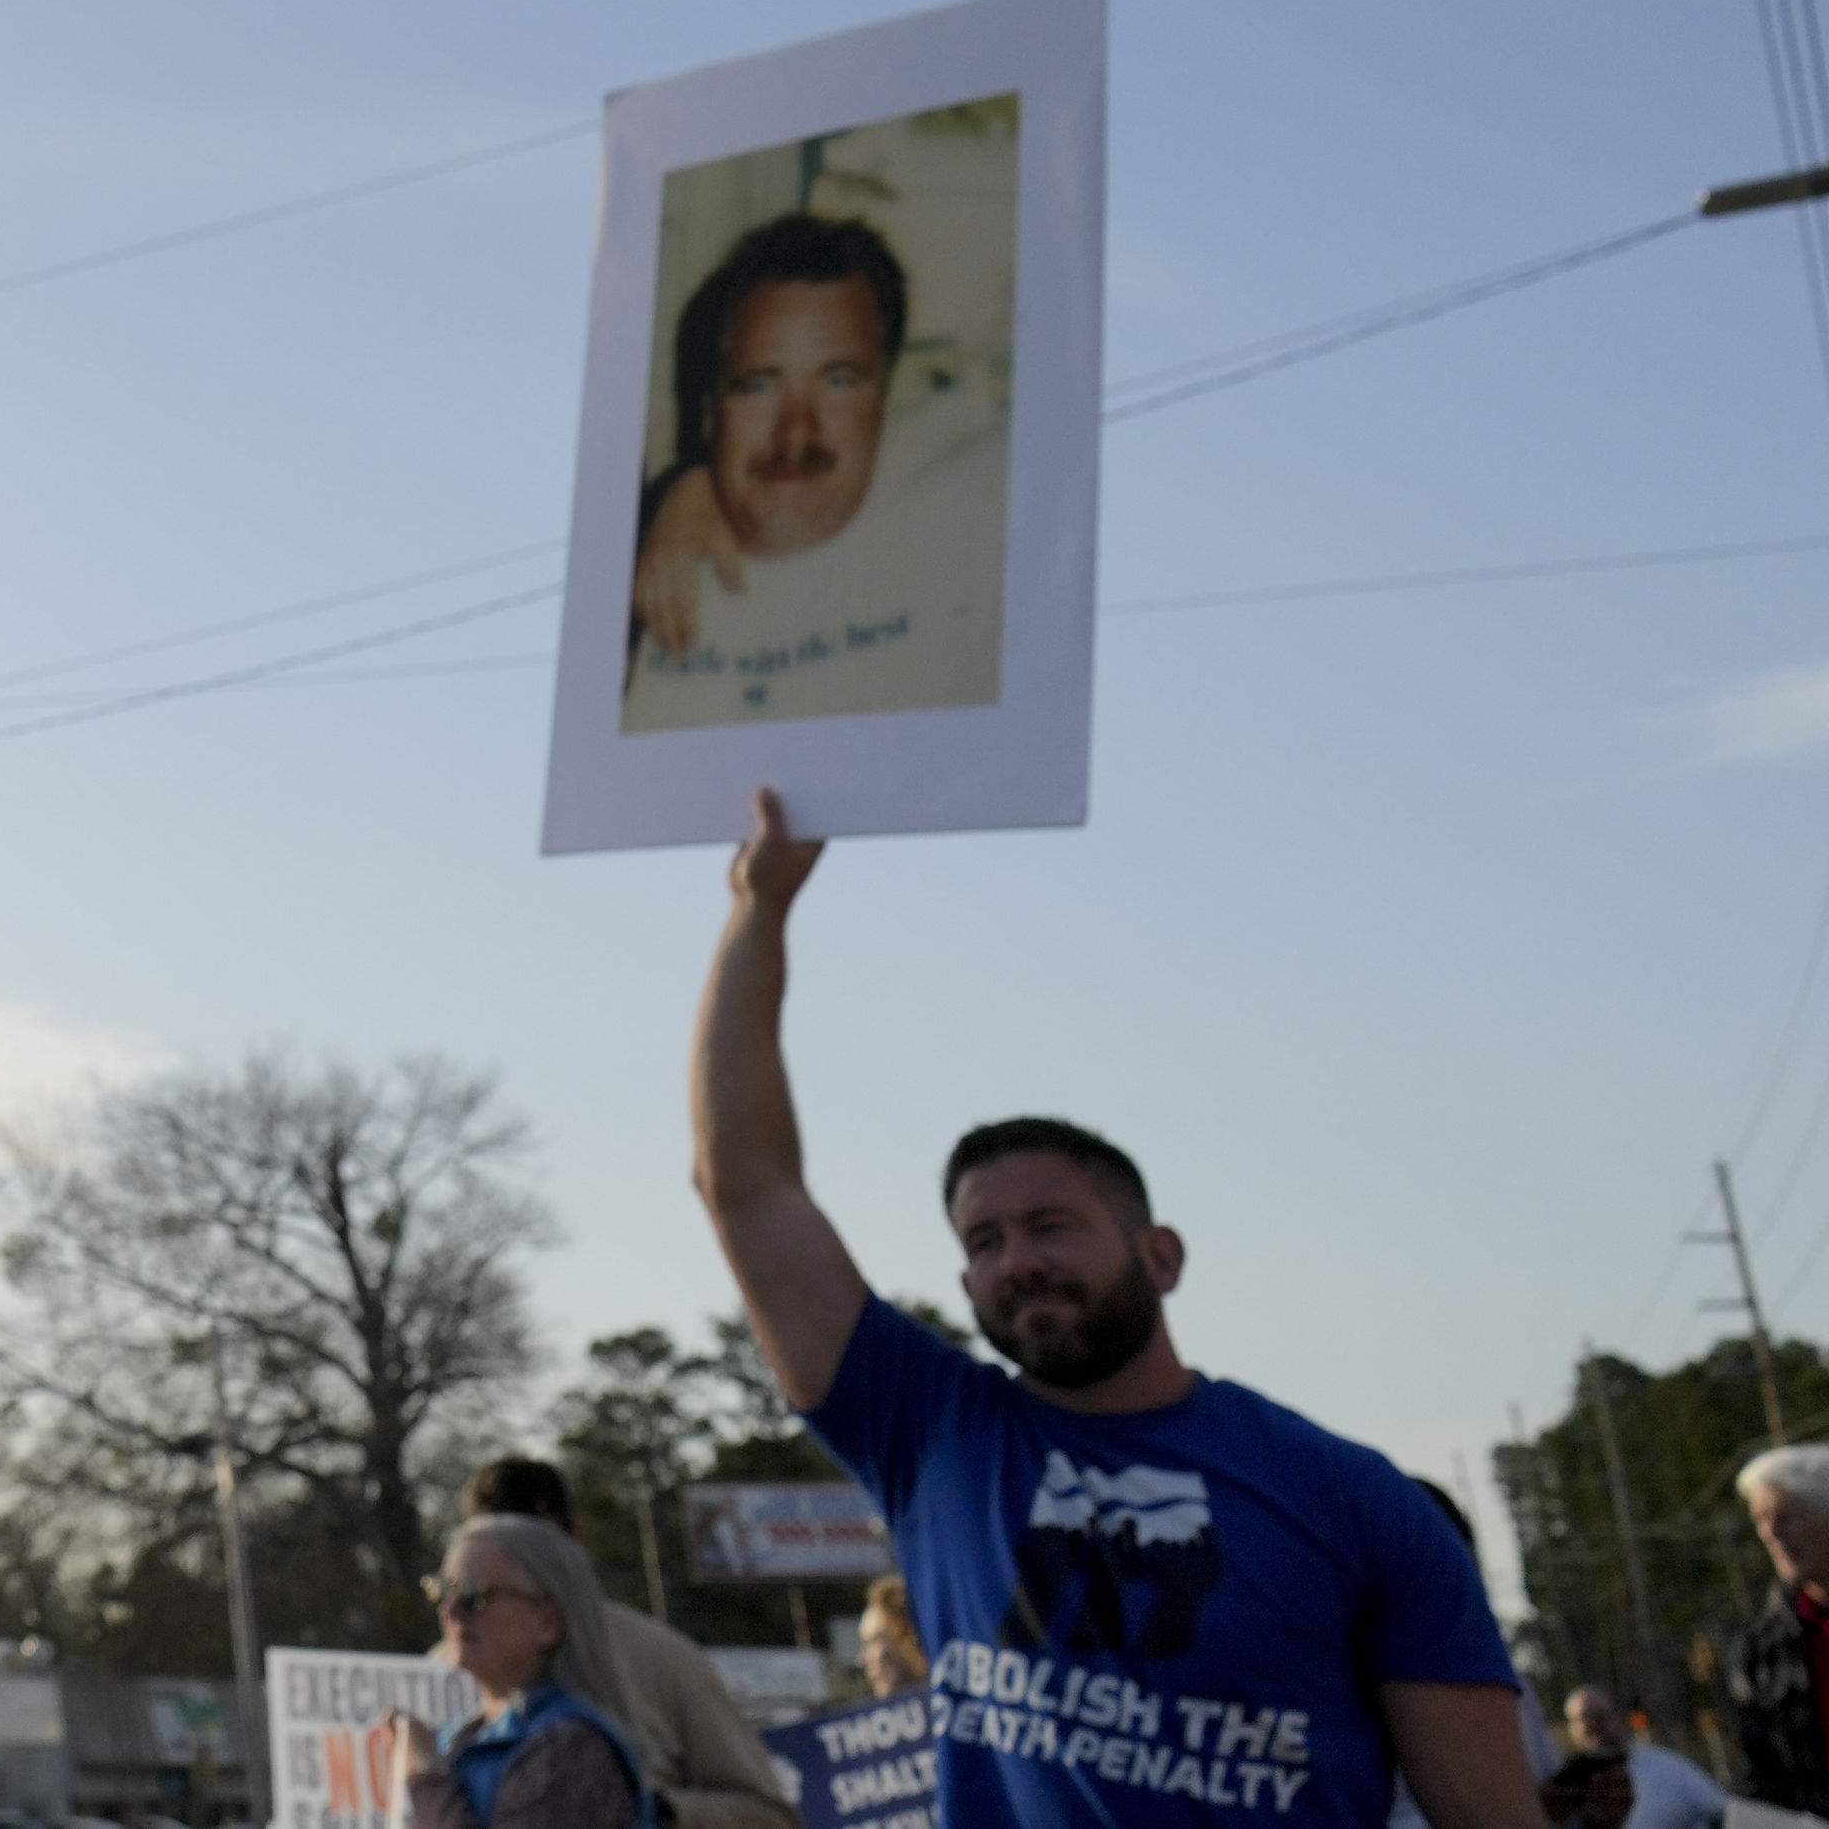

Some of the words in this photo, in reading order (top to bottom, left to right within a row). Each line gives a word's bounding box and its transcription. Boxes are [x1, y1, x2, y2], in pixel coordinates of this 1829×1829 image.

[816, 1698, 927, 1762] THOU
[929, 1638, 1163, 1738] ABOLISH
[1177, 1696, 1311, 1763] THE
[929, 1692, 1059, 1762] DEATH
[1061, 1726, 1311, 1814] PENALTY
